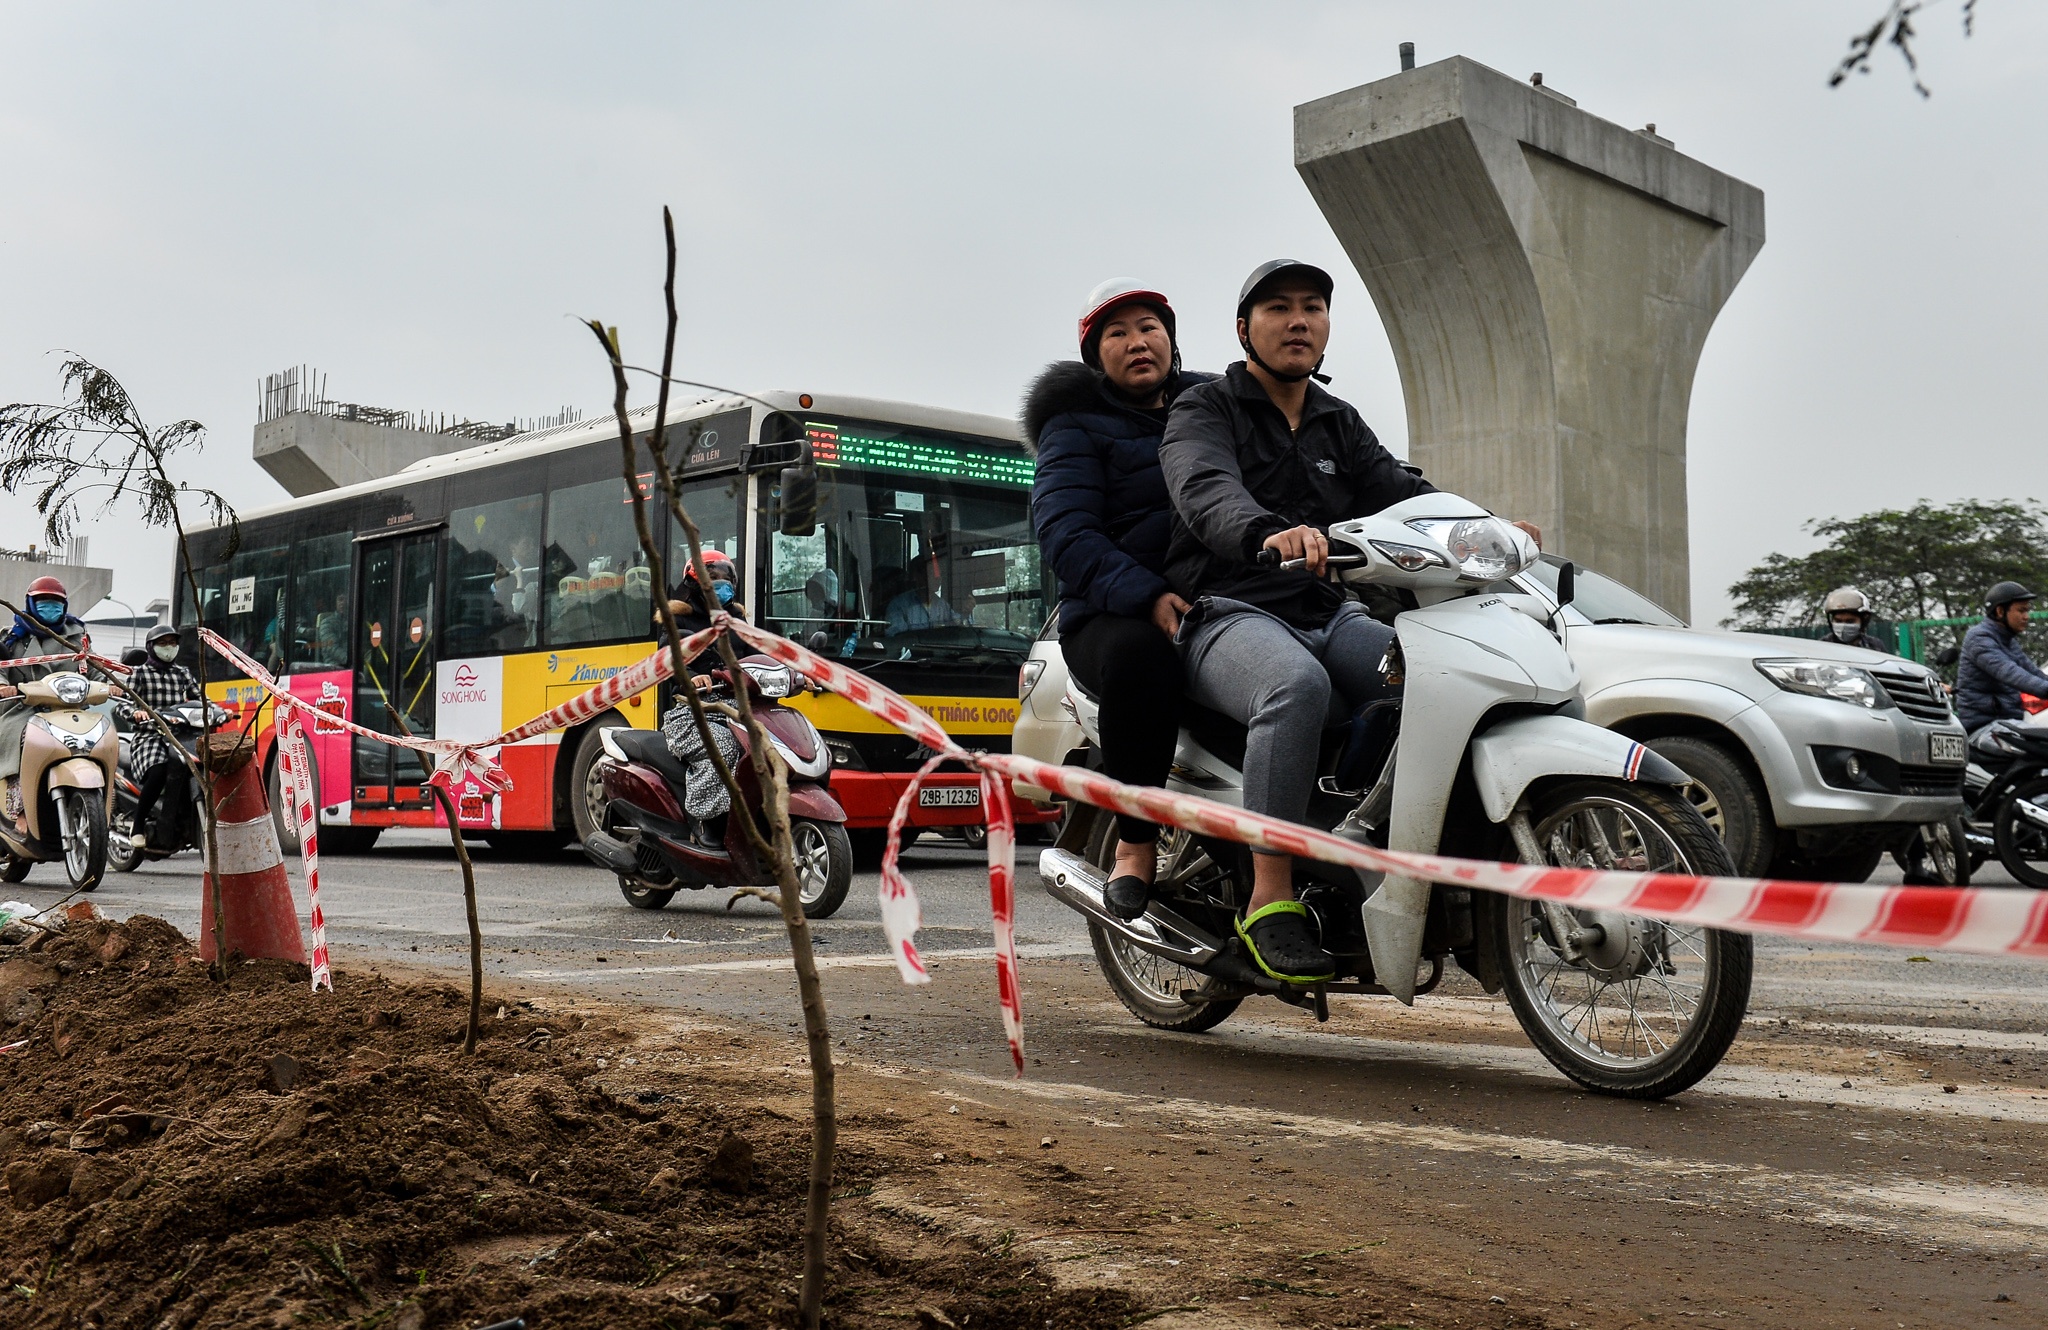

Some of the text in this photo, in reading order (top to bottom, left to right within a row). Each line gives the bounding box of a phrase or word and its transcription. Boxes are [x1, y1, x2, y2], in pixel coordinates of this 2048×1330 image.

[441, 689, 487, 704] SONG HONG
[937, 701, 980, 723] THĂNG
[982, 706, 1016, 723] LONG
[921, 789, 979, 805] 29B-123.26
